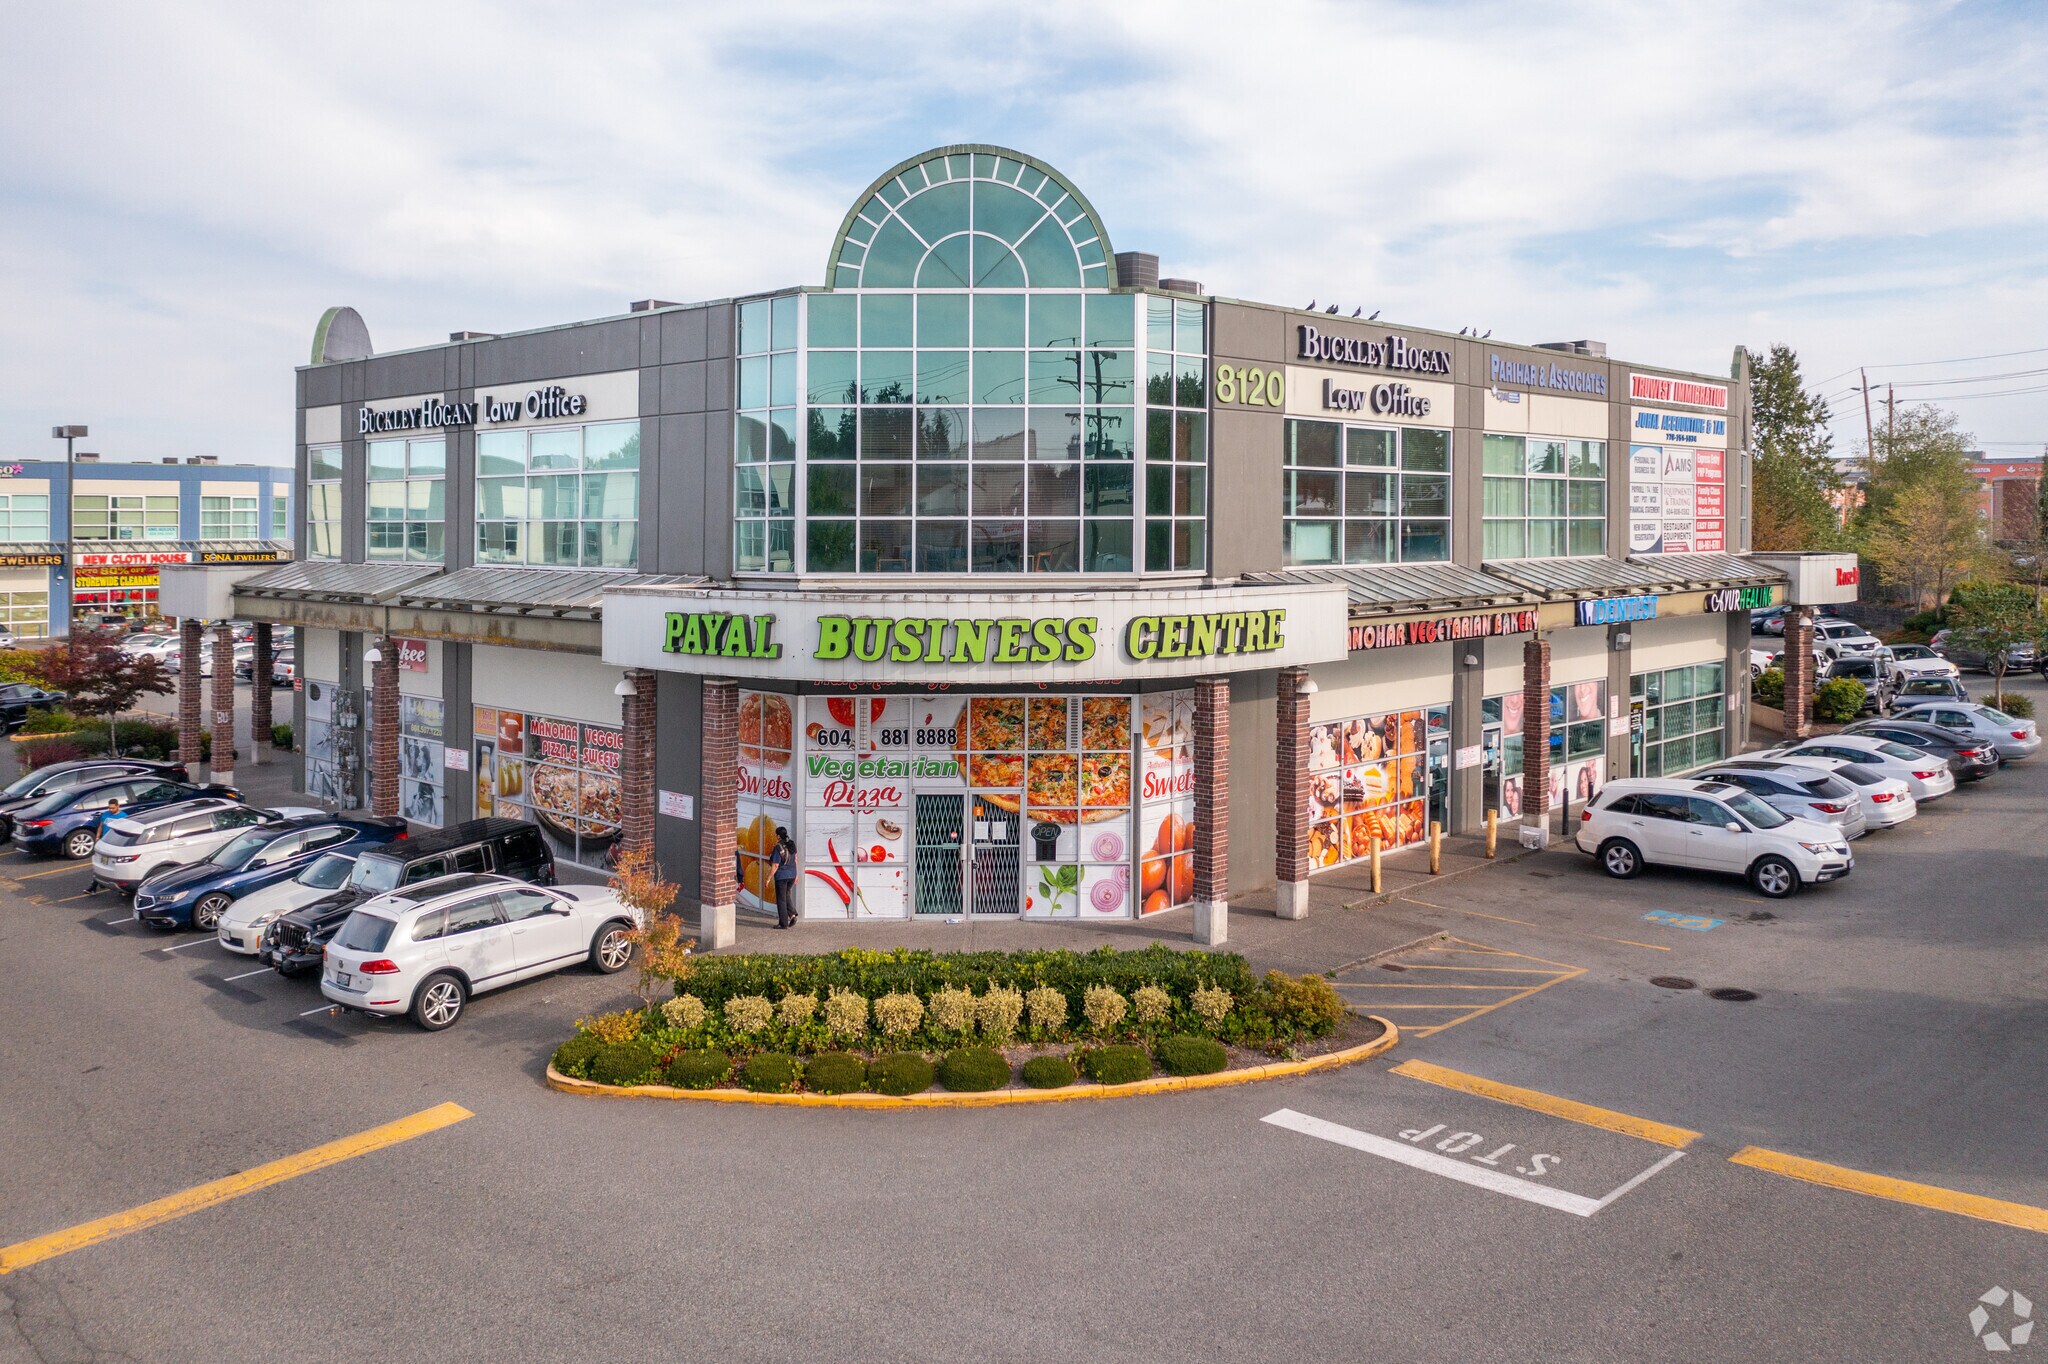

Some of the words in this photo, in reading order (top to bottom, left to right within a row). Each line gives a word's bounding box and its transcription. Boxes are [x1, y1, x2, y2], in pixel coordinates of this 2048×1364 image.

[1216, 364, 1285, 407] 8120
[1490, 354, 1536, 386] PARIHAR
[1538, 366, 1546, 387] &
[1549, 362, 1606, 395] ASSOCIATES
[483, 395, 521, 422] Law
[524, 386, 586, 419] Office
[1323, 378, 1366, 411] Law
[1371, 382, 1431, 417] Office
[1632, 376, 1672, 400] TRUWEST
[1673, 381, 1726, 407] IMMIGRATION
[1661, 415, 1706, 434] ACCOUNTING
[1706, 419, 1712, 434] &
[1713, 420, 1725, 435] TAX
[1669, 498, 1691, 506] TRADING
[1663, 522, 1692, 531] RESTAURANT
[1663, 532, 1692, 541] EQUIPMENTS
[83, 555, 107, 564] NEW
[111, 554, 146, 564] CLOTH
[150, 553, 187, 563] HOUSE
[203, 554, 231, 562] SONA
[75, 576, 119, 587] STOREWIDE
[1595, 596, 1659, 624] DENTIST
[662, 612, 783, 659] PAYAL
[813, 615, 1098, 663] BUSINESS
[1125, 608, 1286, 661] CENTRE
[1408, 615, 1491, 645] VEGETARIAN
[1494, 610, 1540, 636] BAKERY
[398, 640, 426, 662] kee
[530, 720, 578, 742] MANOHAR
[584, 728, 623, 749] VEGGIE
[817, 729, 850, 746] 604
[881, 729, 909, 746] 881
[916, 728, 957, 745] 8888
[541, 740, 567, 759] PIZZA
[568, 746, 578, 762] &
[583, 748, 620, 769] SWEETS
[806, 755, 959, 782] Vegetarian
[736, 766, 792, 800] Sweets
[823, 780, 903, 815] Pizza
[1143, 768, 1196, 799] Sweets
[1032, 826, 1058, 837] OPEN
[1399, 1124, 1562, 1176] STOP
